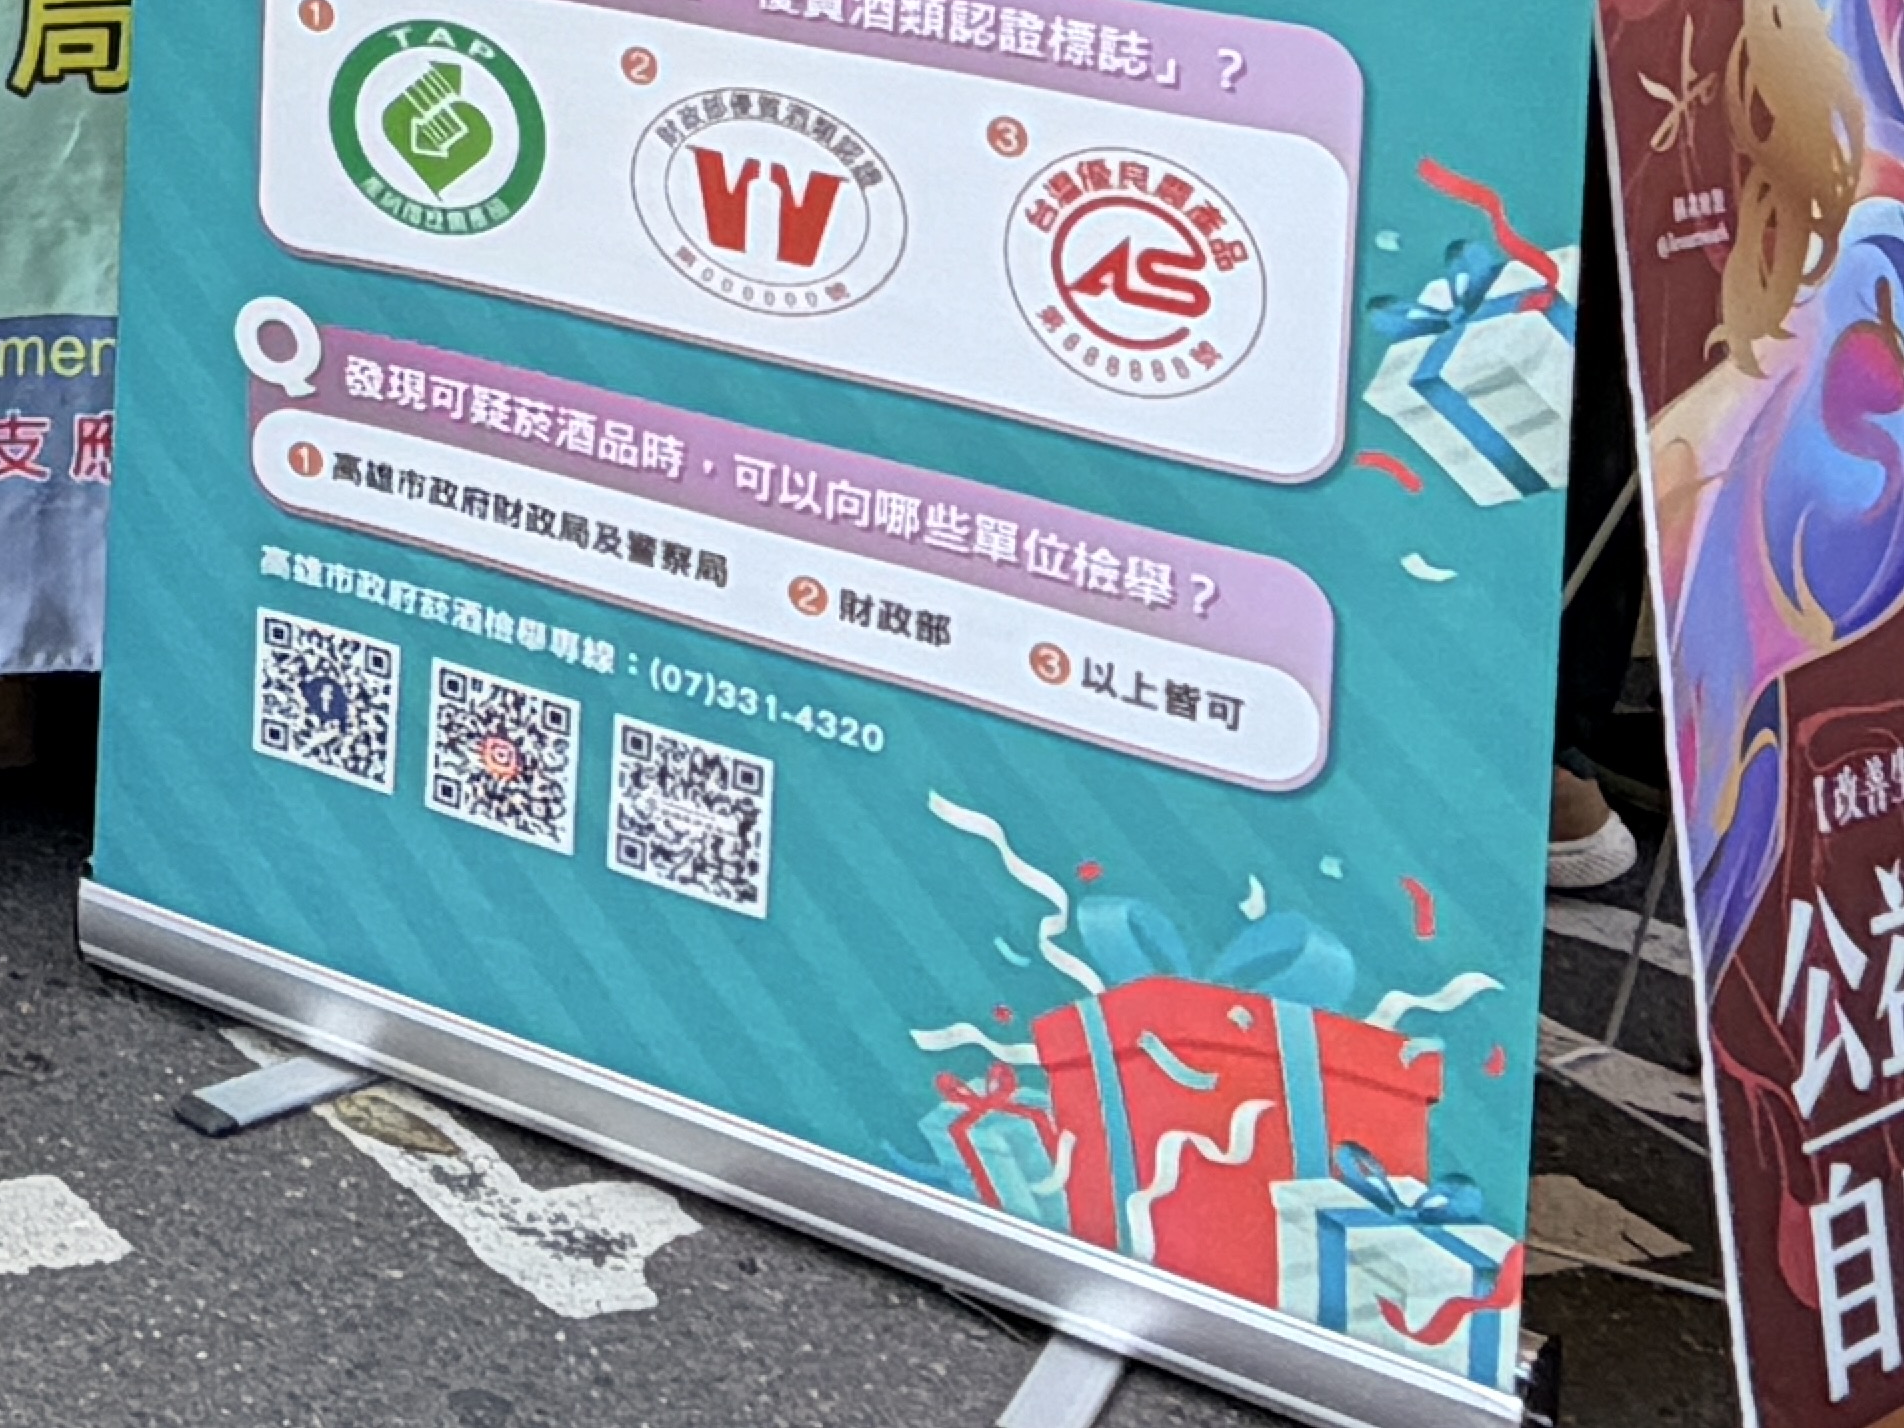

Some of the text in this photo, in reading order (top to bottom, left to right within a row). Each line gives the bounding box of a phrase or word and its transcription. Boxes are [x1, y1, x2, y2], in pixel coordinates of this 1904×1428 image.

[331, 451, 730, 589] 高雄市政府財政局及警察局
[838, 588, 953, 647] 財政部
[1081, 656, 1246, 732] 以上皆可
